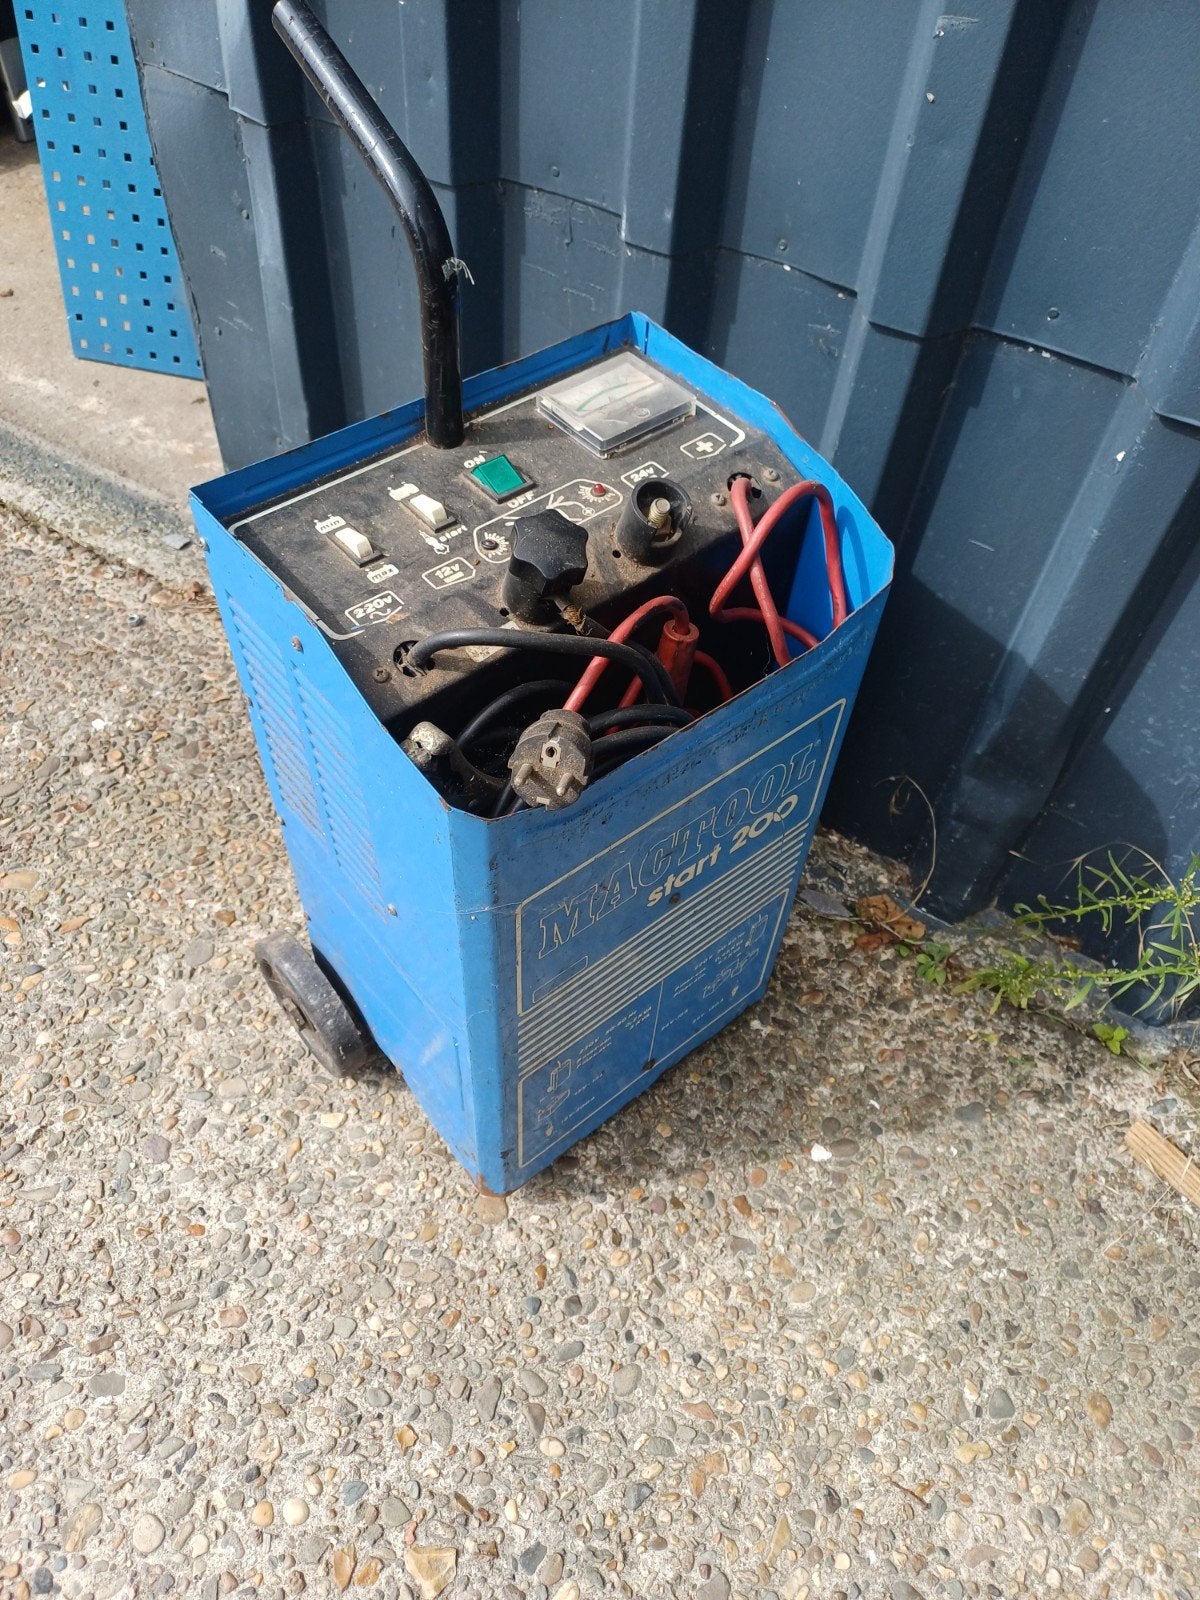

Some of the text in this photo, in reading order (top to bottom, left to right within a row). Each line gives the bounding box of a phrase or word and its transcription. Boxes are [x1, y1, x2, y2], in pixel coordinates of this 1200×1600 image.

[463, 454, 486, 469] ON
[506, 490, 535, 509] OFF
[320, 520, 340, 531] min
[439, 524, 468, 542] start
[371, 568, 394, 582] max
[538, 746, 817, 960] MACTOOL
[647, 794, 799, 907] start 200
